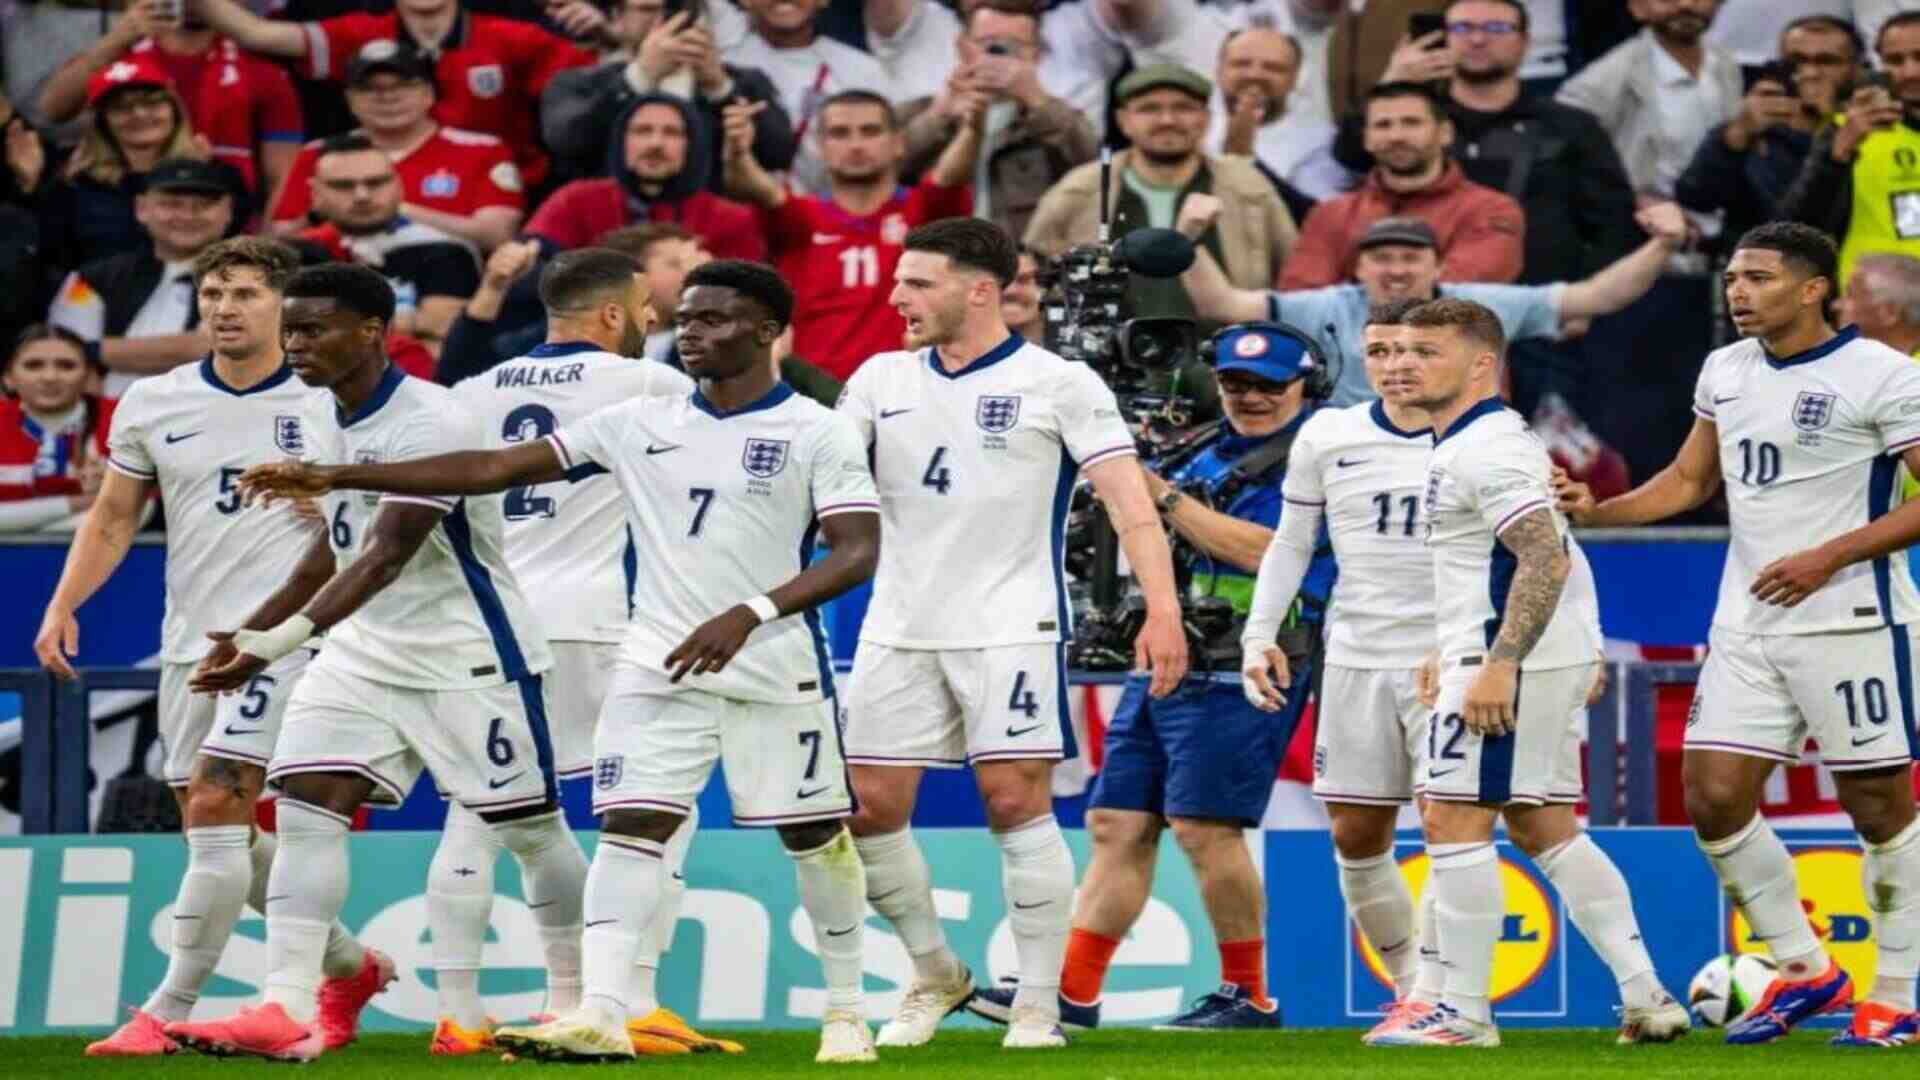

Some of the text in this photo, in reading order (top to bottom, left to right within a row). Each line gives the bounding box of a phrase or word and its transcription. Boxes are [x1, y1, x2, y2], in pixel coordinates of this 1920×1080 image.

[838, 245, 879, 288] 11
[496, 363, 585, 388] WALKER
[921, 447, 951, 494] 4
[1738, 438, 1781, 486] 10
[215, 467, 245, 514] 5
[689, 488, 715, 536] 7
[1372, 491, 1419, 537] 11
[332, 501, 352, 549] 6
[240, 674, 276, 719] 5
[1009, 671, 1038, 717] 4
[1835, 677, 1889, 727] 10
[486, 717, 516, 767] 6
[798, 730, 822, 781] 7
[1429, 711, 1466, 760] 12
